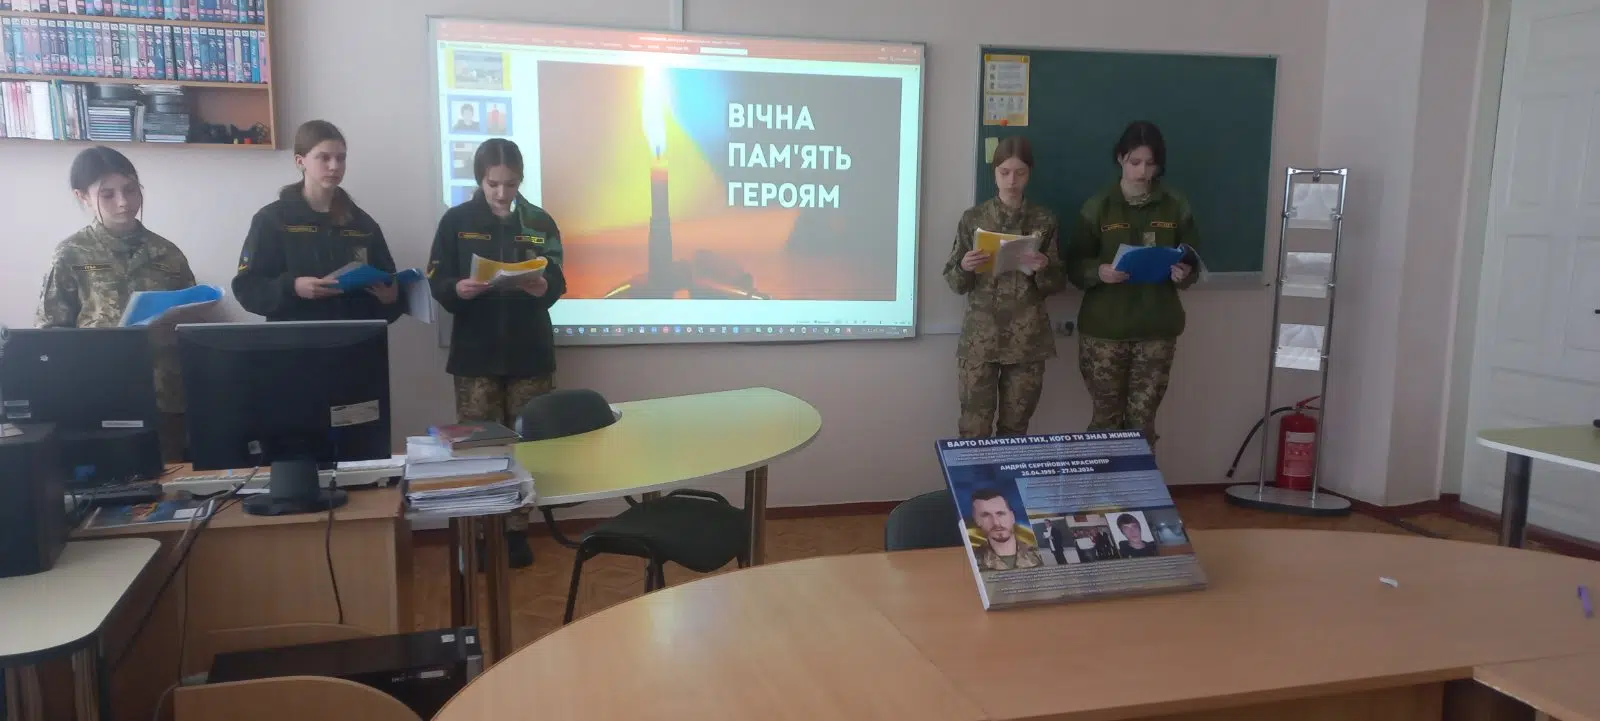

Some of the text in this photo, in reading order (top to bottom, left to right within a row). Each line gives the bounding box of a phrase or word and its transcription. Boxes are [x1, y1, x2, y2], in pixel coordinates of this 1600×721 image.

[728, 102, 816, 131] ВІЧНА
[728, 142, 852, 170] ПАМ'ЯТЬ
[728, 181, 840, 209] ГЕРОЯМ
[947, 439, 977, 448] ВАРТО
[978, 437, 1027, 446] ПАМ'ЯТАТИ
[1028, 436, 1049, 444] ТИХ,
[1108, 431, 1141, 439] ЖИВИМ
[1000, 458, 1110, 471] АНДРІЙ СЕРГІЙОВИЧ КРАСНОПІР
